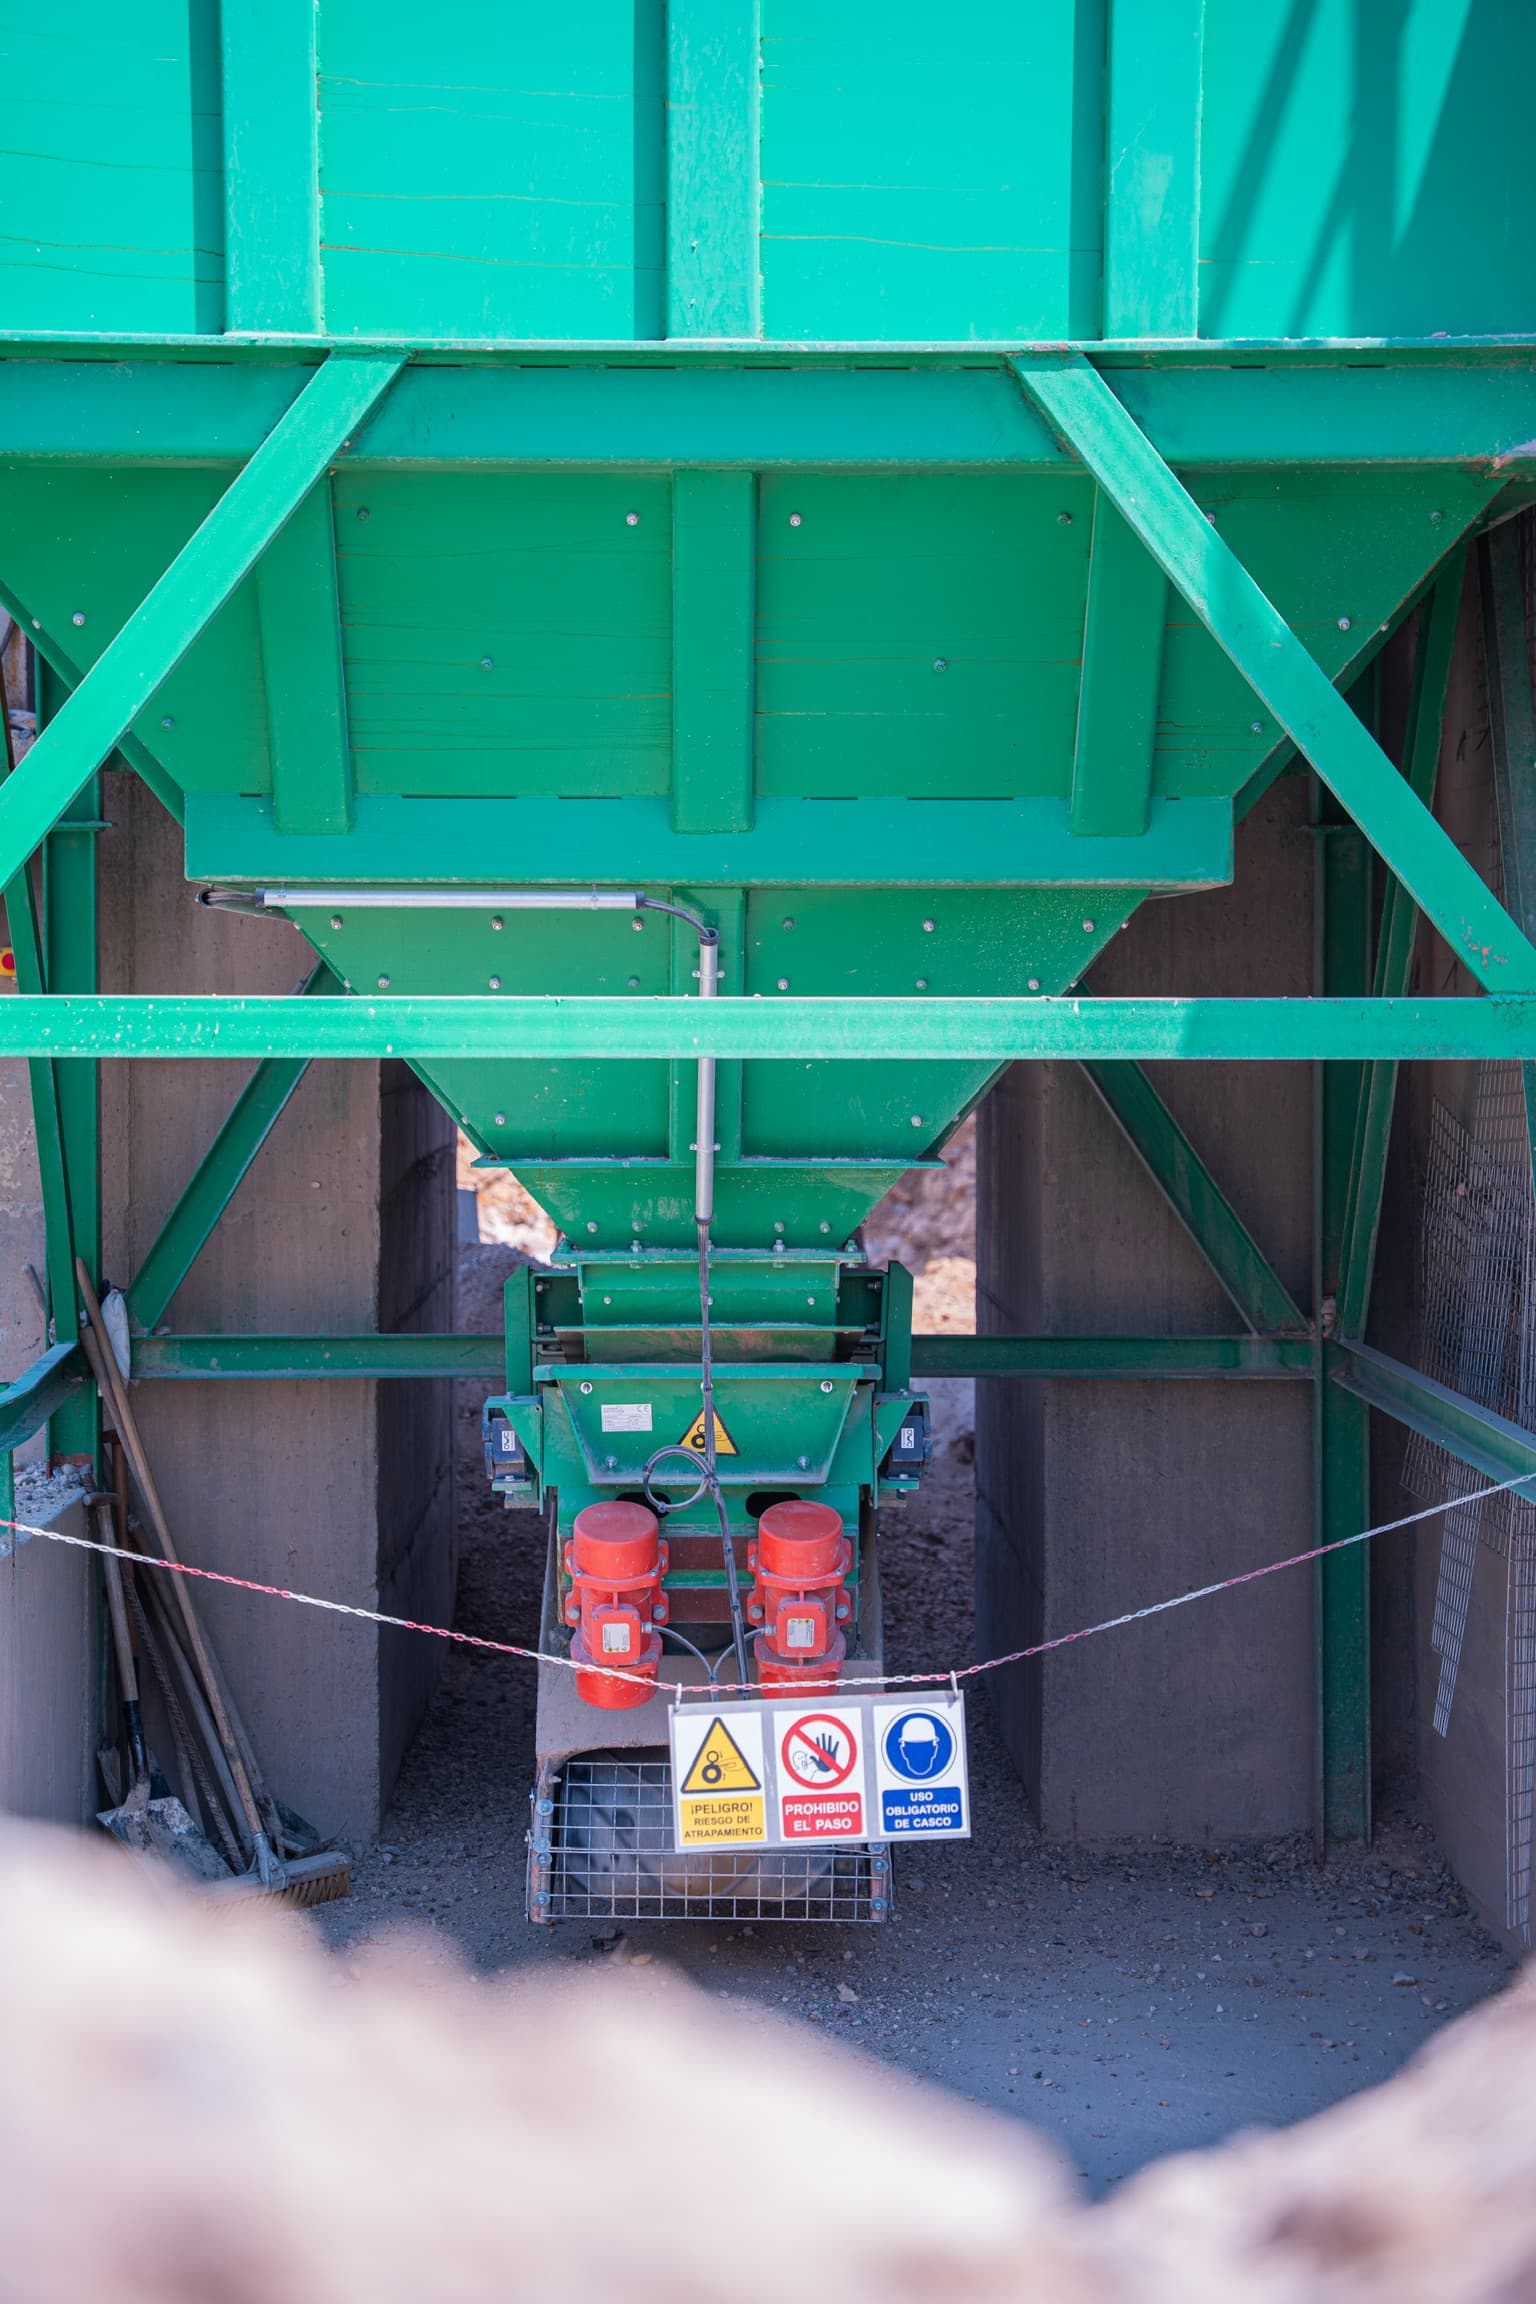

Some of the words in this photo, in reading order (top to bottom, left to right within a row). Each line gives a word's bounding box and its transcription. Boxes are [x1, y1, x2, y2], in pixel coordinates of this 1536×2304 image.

[910, 1791, 933, 1802] USO
[691, 1802, 753, 1814] ¡PELIGRO!
[785, 1801, 859, 1815] PROHIBIDO
[886, 1803, 959, 1816] OBLIGATORIO
[694, 1816, 733, 1825] RIESGO
[737, 1815, 751, 1824] DE
[793, 1820, 812, 1832] EL
[815, 1817, 852, 1831] PASO
[894, 1818, 910, 1829] DE
[913, 1816, 952, 1828] CASCO
[684, 1826, 763, 1838] ATRAPAMIENTO
